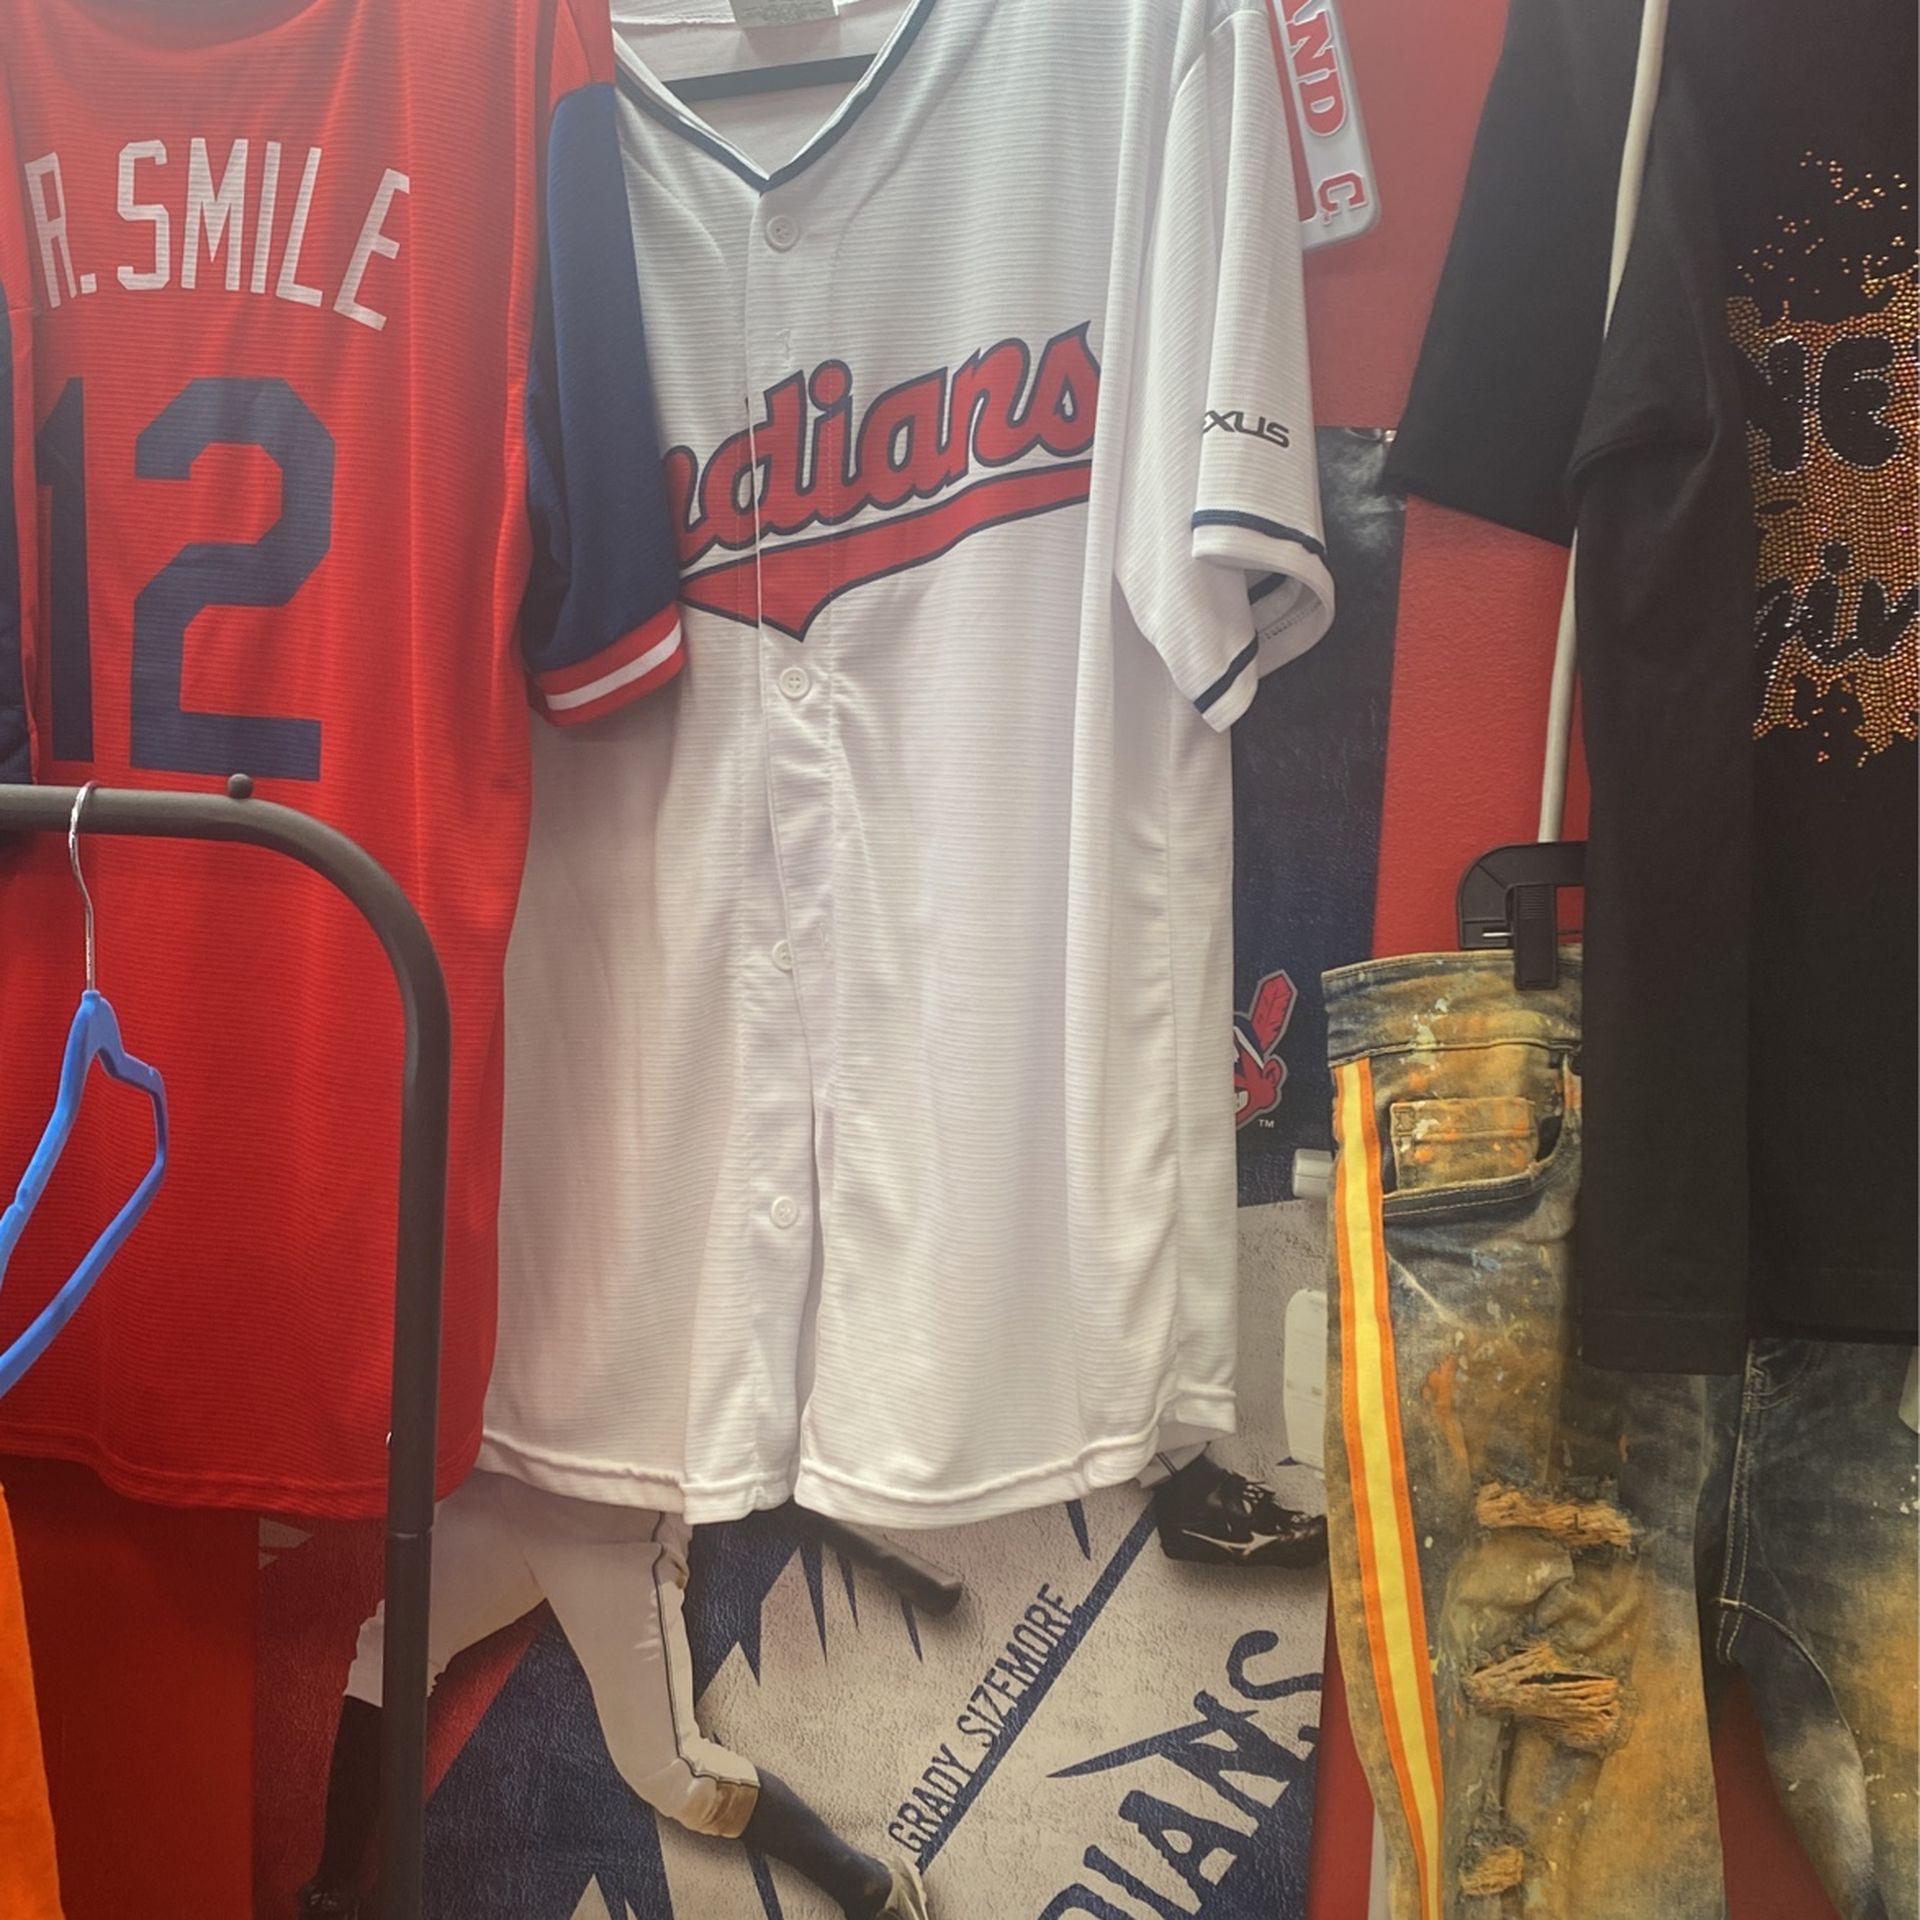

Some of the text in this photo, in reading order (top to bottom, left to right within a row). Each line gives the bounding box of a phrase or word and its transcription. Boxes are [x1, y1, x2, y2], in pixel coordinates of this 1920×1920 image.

[1280, 0, 1347, 136] ND
[1202, 409, 1289, 449] XUS
[36, 376, 336, 781] 12
[888, 1582, 1084, 1853] GRADY SIZEMORE
